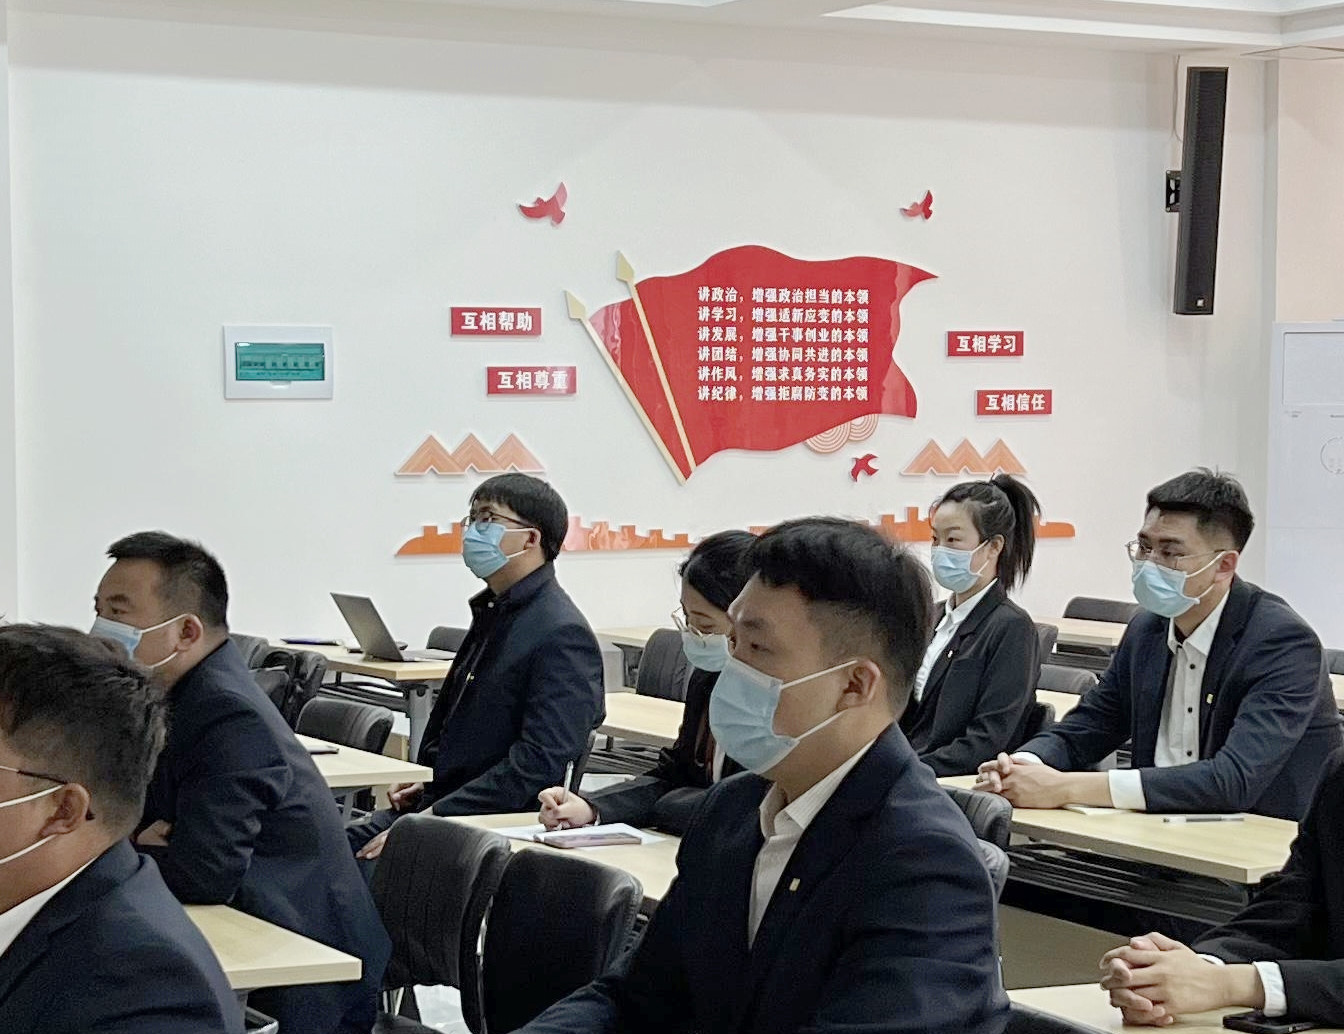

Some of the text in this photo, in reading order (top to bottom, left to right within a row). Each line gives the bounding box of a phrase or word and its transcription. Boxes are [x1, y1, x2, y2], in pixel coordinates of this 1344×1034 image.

[461, 311, 533, 331] 互相帮助
[956, 335, 1016, 353] 互相学习
[497, 370, 568, 390] 互相尊重
[985, 393, 1045, 411] 互相信任
